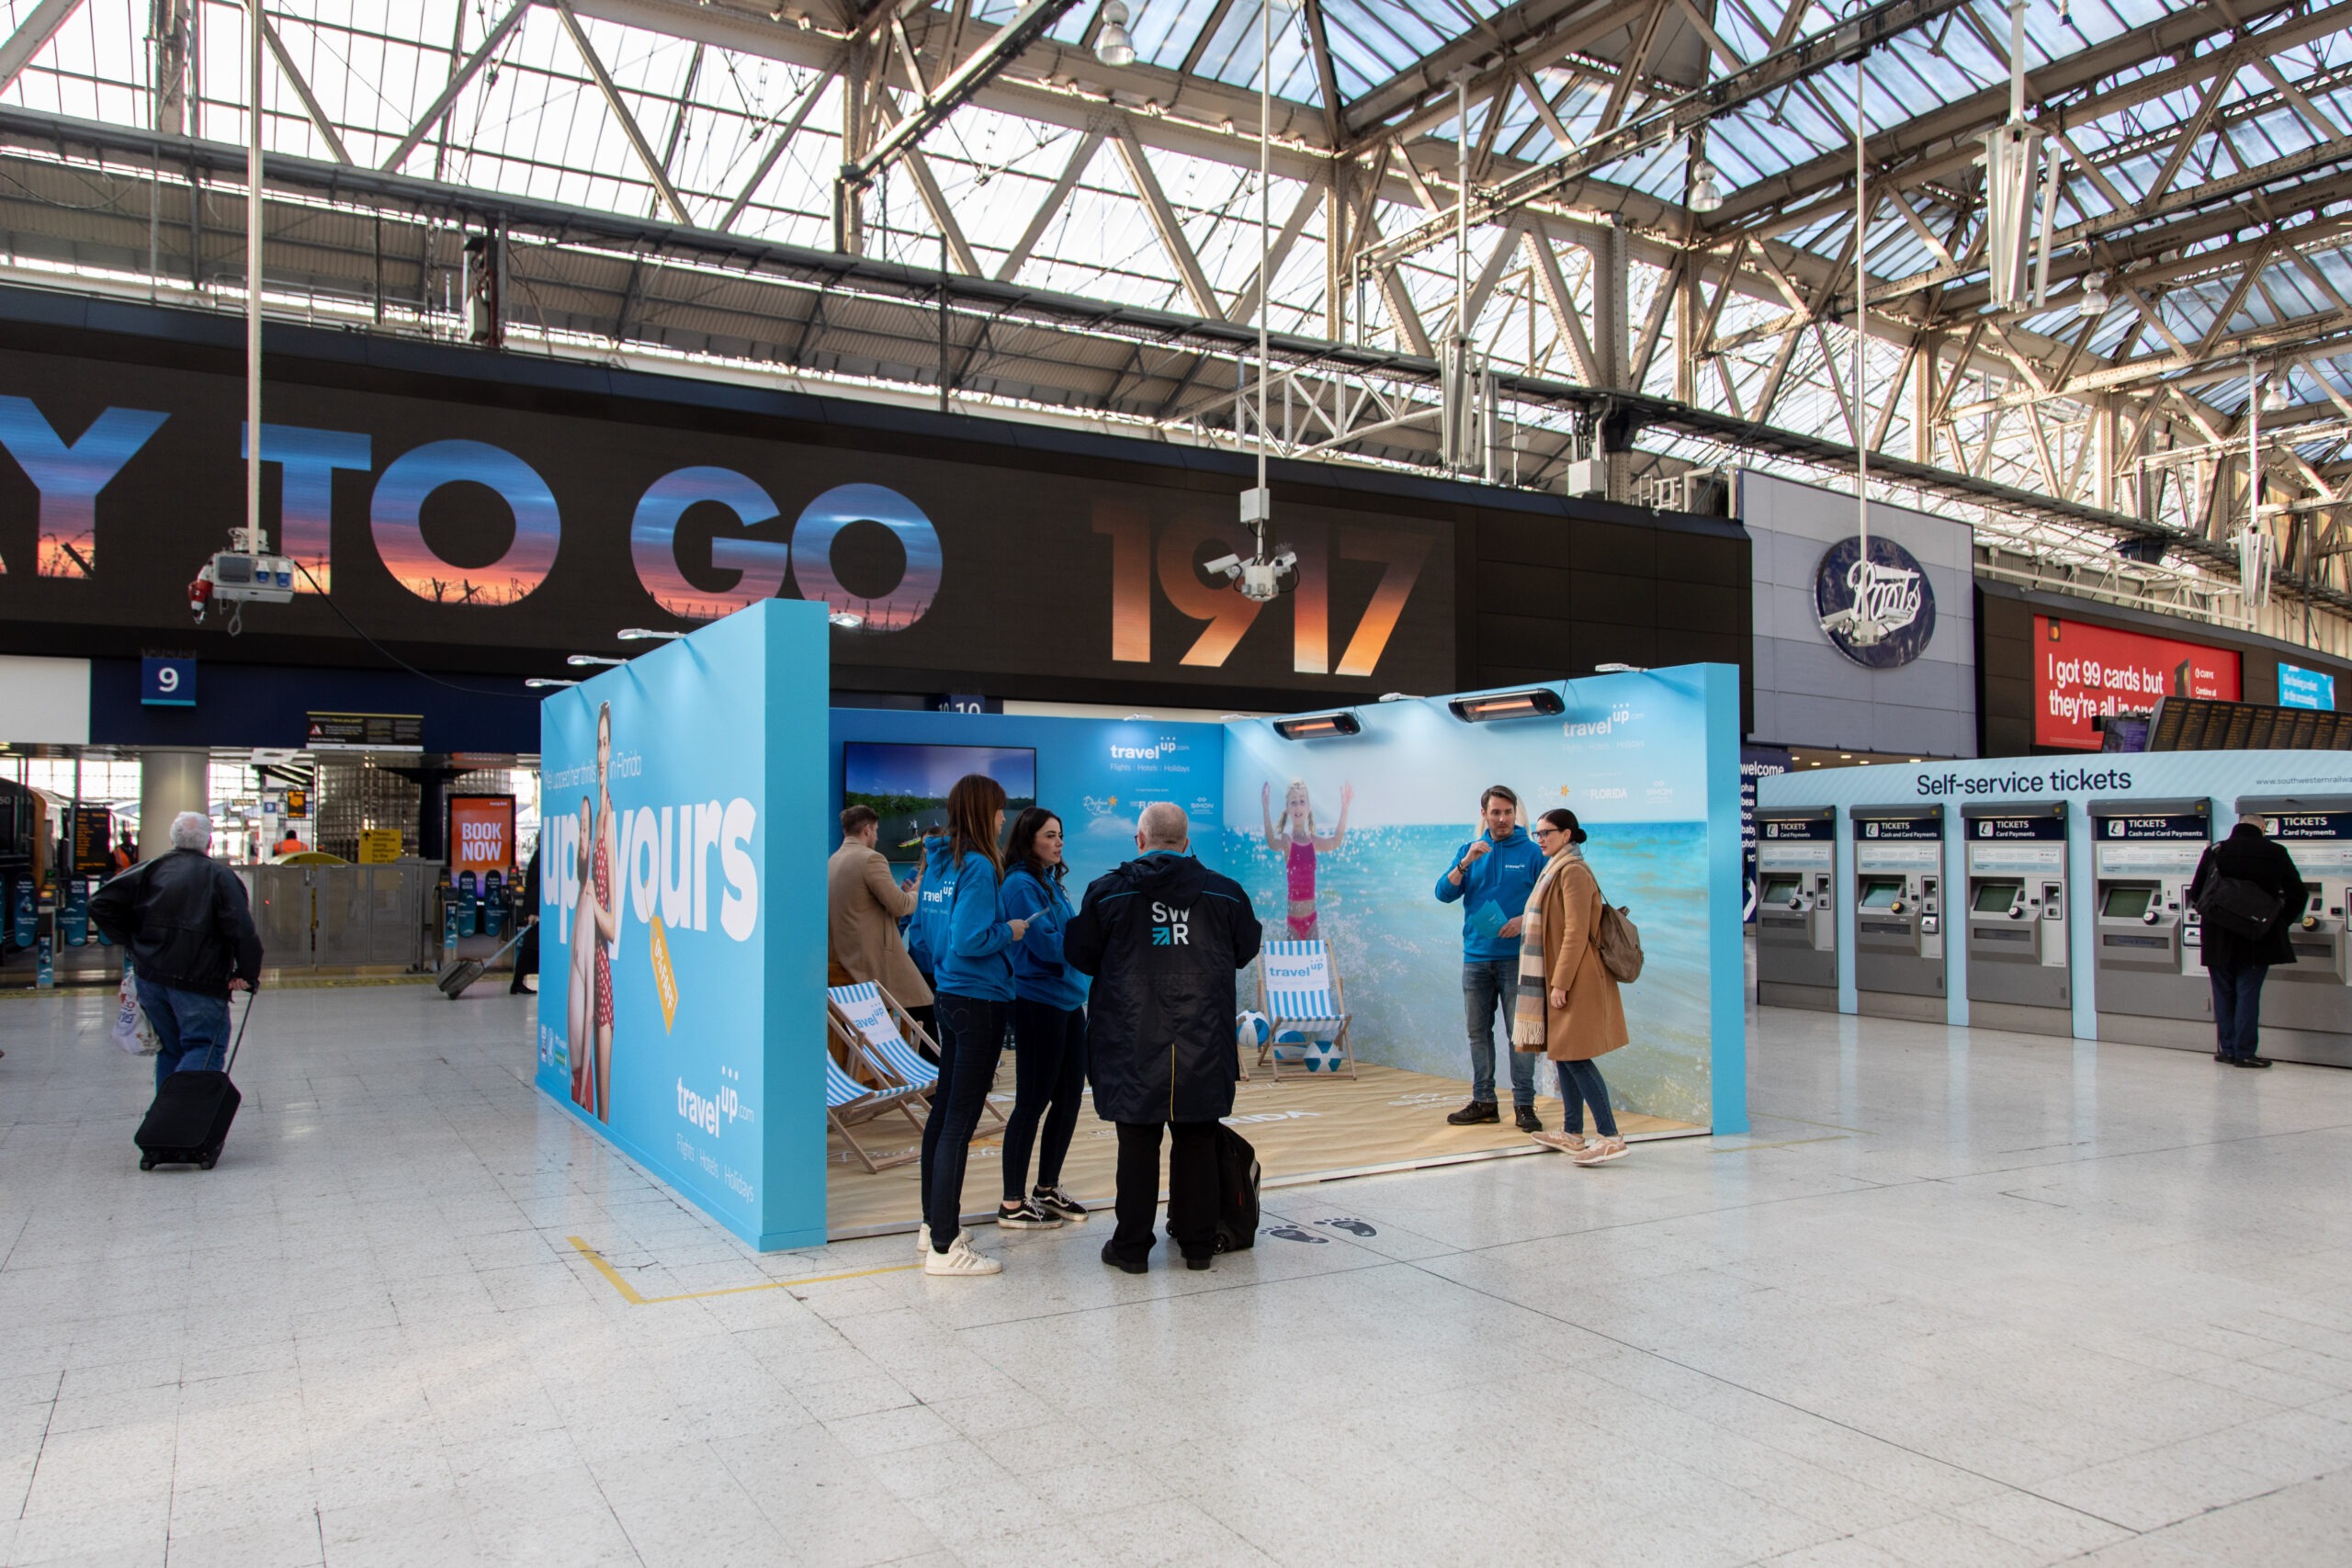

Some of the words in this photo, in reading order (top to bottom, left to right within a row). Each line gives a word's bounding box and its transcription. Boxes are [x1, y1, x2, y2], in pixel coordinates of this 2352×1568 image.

[0, 394, 172, 581] Y
[242, 421, 561, 606] TO
[630, 466, 943, 635] GO
[1091, 499, 1437, 677] 1917
[1847, 559, 1922, 636] Boots
[158, 667, 180, 693] 9
[2048, 653, 2053, 680] I
[2056, 658, 2080, 688] got
[2083, 660, 2101, 686] 99
[2104, 665, 2141, 692] cards
[2143, 668, 2164, 694] but
[956, 702, 981, 714] 10
[2049, 689, 2097, 725] they're
[2100, 695, 2115, 716] all
[1563, 716, 1611, 737] travel
[1110, 744, 1159, 760] travel
[1110, 763, 1131, 772] Flights
[1137, 763, 1158, 772] Hotels
[1164, 764, 1190, 773] Holidays
[1740, 761, 1784, 776] welcome
[1917, 773, 2043, 796] Self-service
[2050, 768, 2132, 792] tickets
[1589, 787, 1628, 800] FLORIDA
[462, 822, 502, 840] BOOK
[1996, 820, 2029, 829] TICKETS
[2128, 819, 2166, 828] TICKETS
[2282, 817, 2327, 826] TICKETS
[462, 841, 502, 862] NOW
[543, 813, 581, 945] up
[609, 797, 758, 960] yours
[1152, 901, 1190, 923] SW
[1172, 923, 1190, 945] R
[1270, 966, 1310, 977] travel
[853, 1013, 879, 1029] avel
[677, 1076, 719, 1138] travel
[677, 1133, 695, 1162] Flights
[699, 1148, 719, 1179] Hotels
[724, 1164, 754, 1205] Holidays
